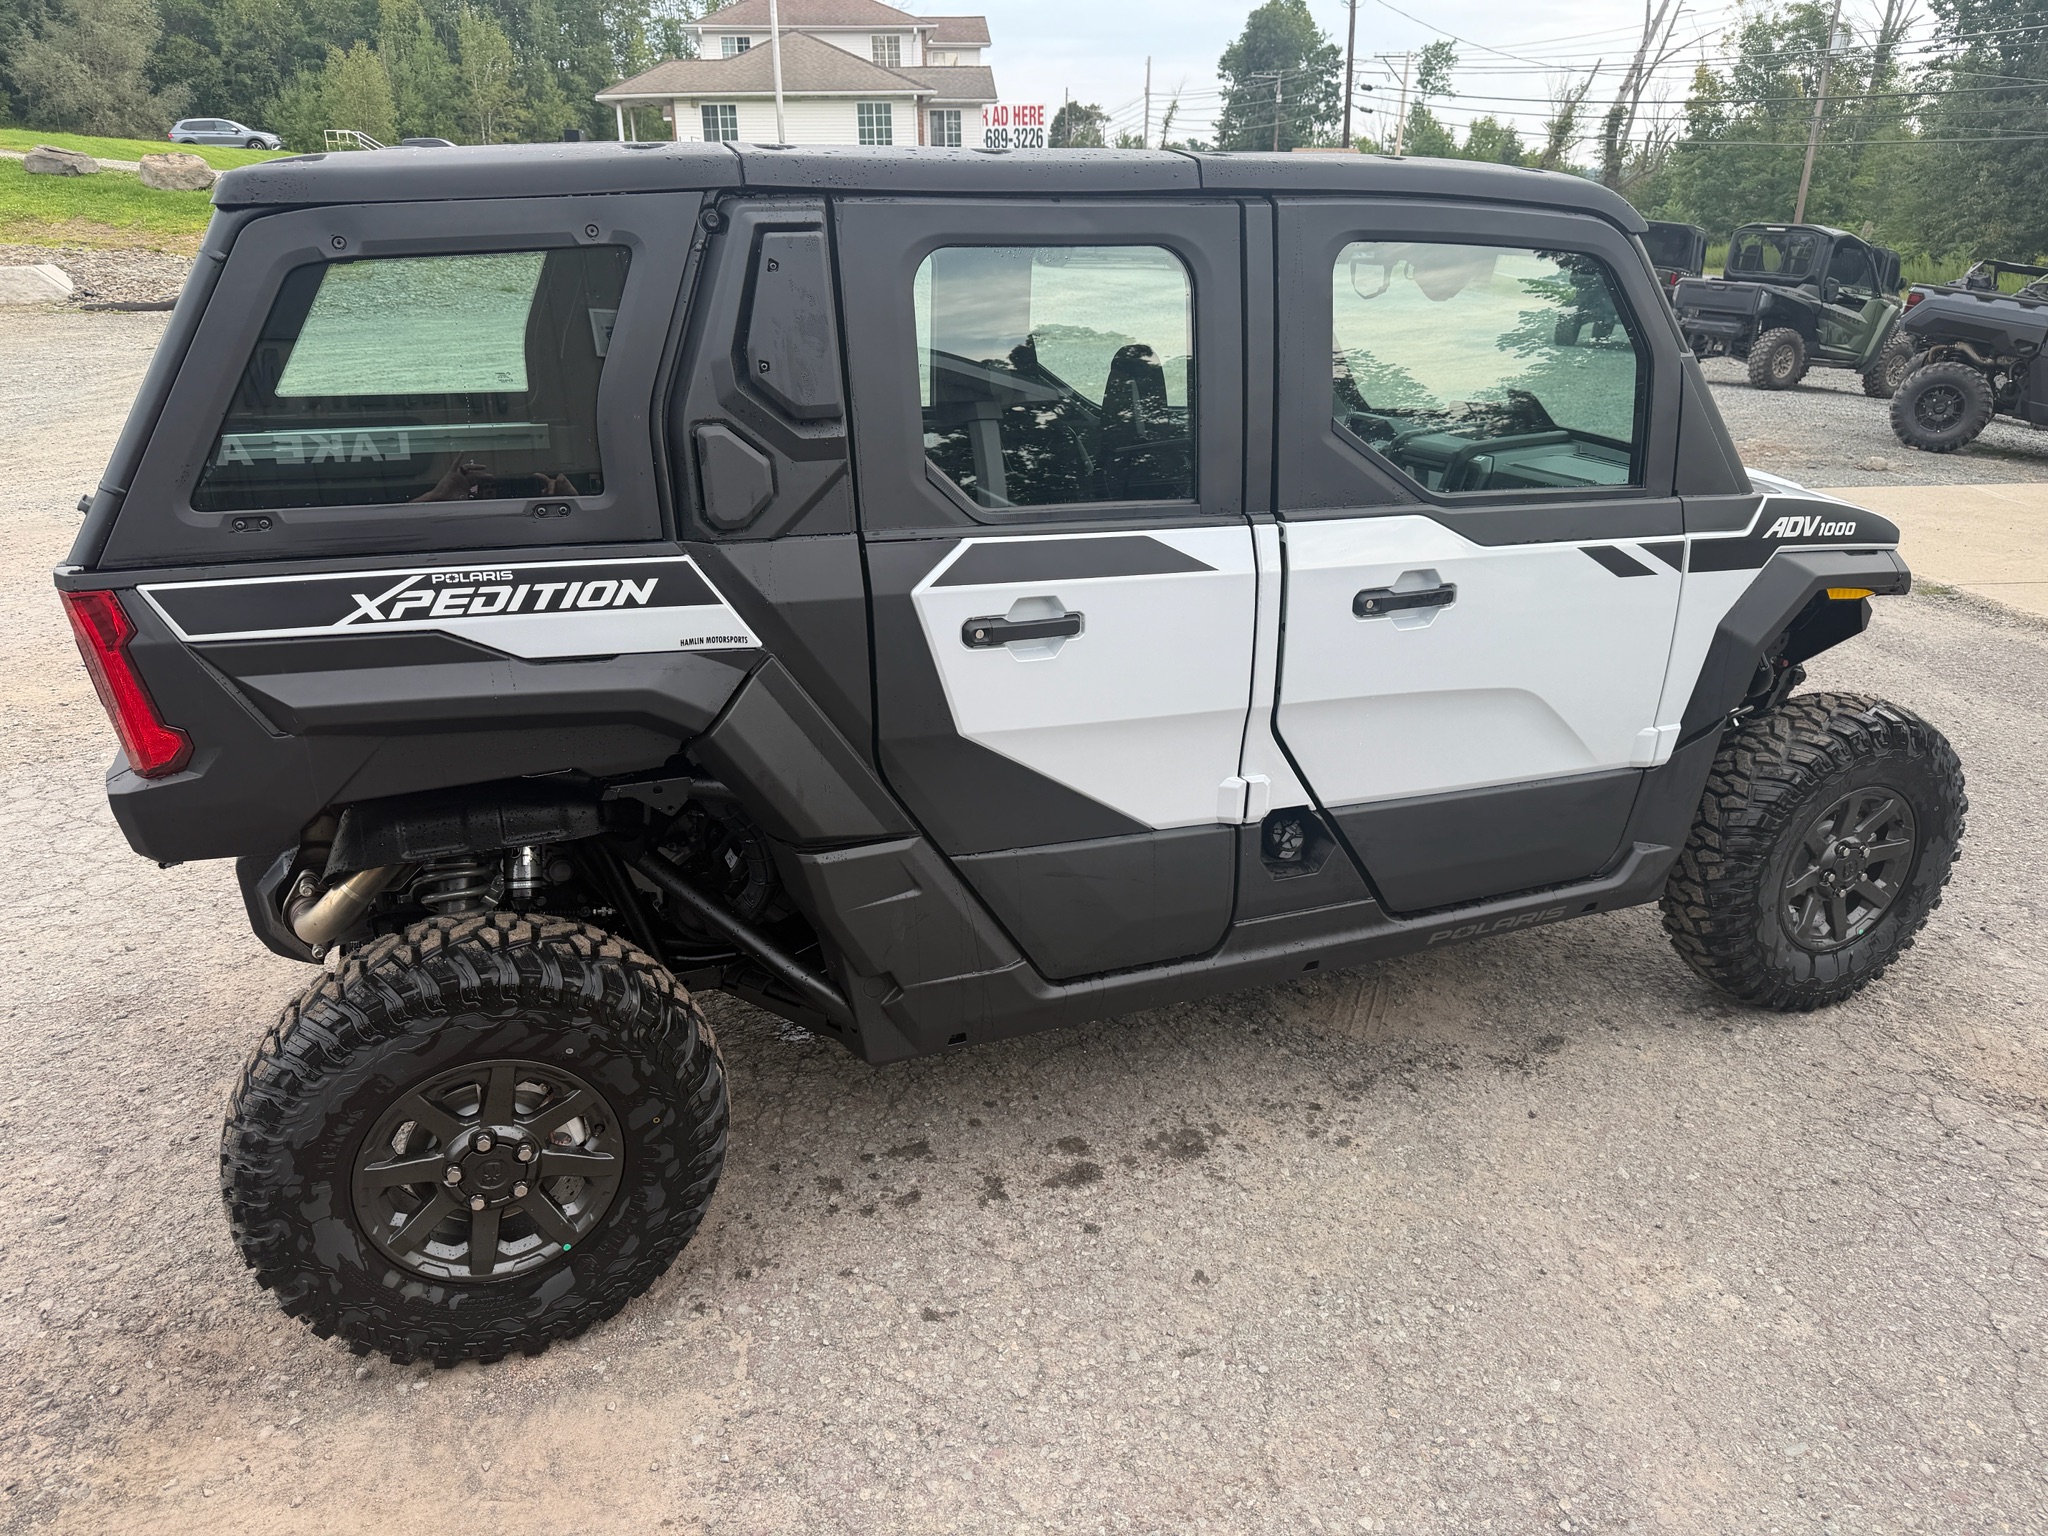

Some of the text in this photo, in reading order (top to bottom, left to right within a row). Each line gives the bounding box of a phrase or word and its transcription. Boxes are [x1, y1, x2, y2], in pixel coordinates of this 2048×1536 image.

[992, 106, 1009, 126] AD
[1013, 105, 1045, 126] HERE
[1762, 515, 1857, 539] ADV 1000
[431, 570, 514, 584] POLARIS
[337, 574, 659, 626] XPEDITION
[680, 635, 748, 647] HAMLIN MOTORSPORTS
[1426, 905, 1567, 945] POLARIS
